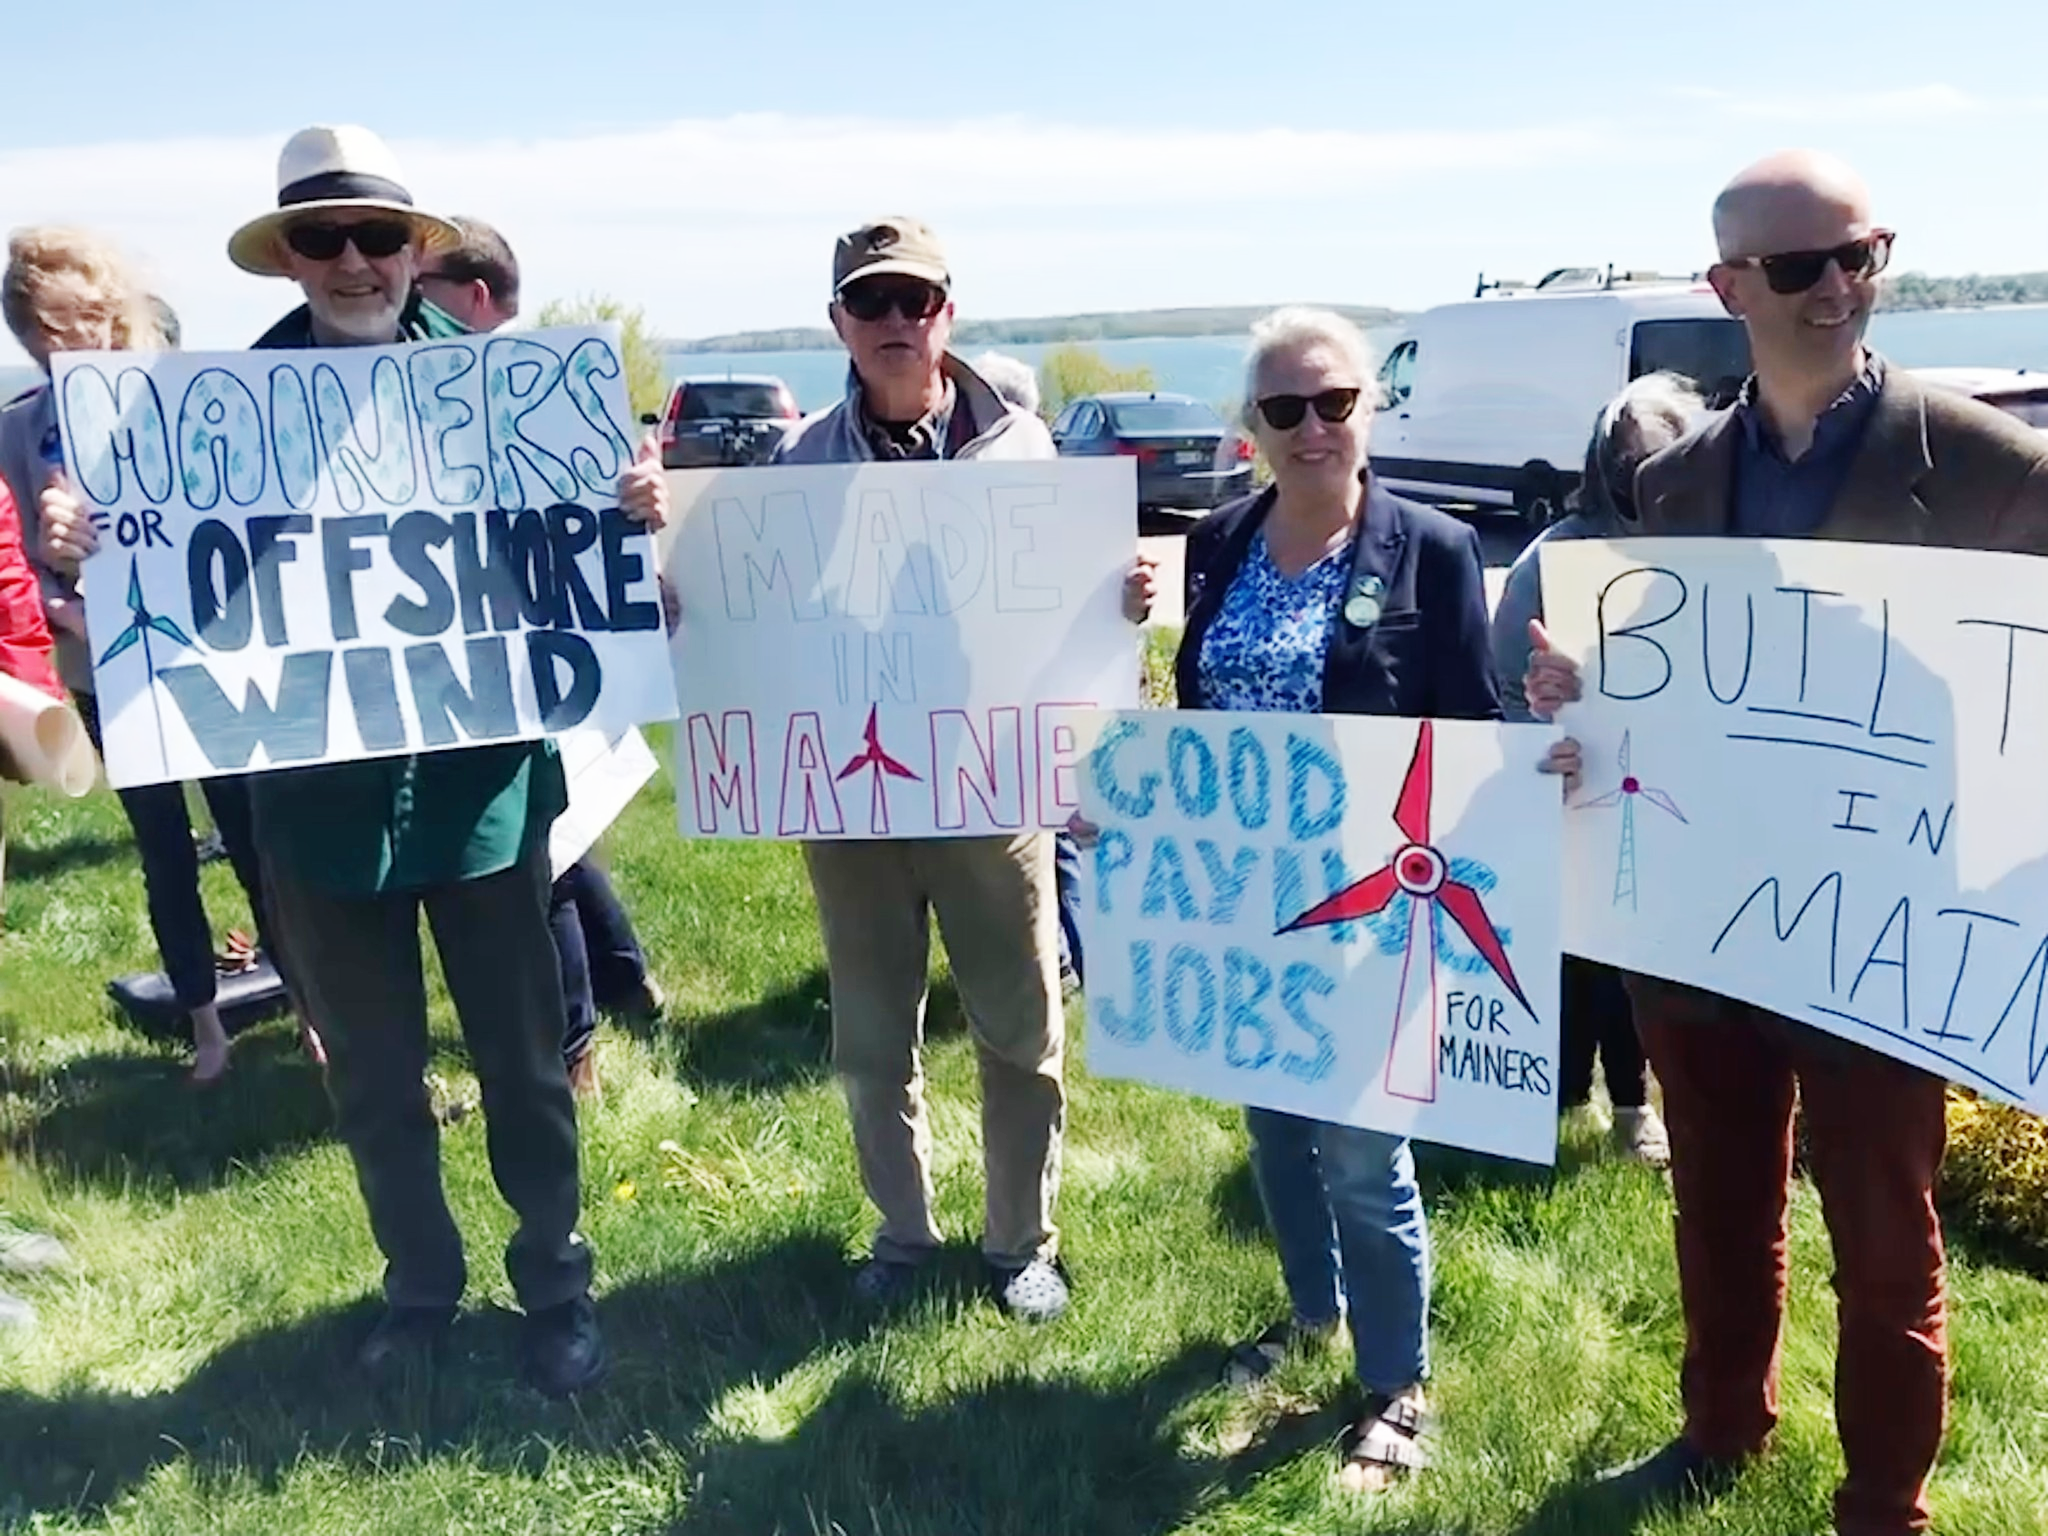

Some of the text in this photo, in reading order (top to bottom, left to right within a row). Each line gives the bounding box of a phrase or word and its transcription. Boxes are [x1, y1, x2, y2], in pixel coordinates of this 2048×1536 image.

[62, 337, 635, 512] MAINERS
[187, 502, 660, 652] OFFSHORE
[711, 483, 1062, 622] MADE
[157, 629, 602, 770] WIND
[831, 631, 917, 706] IN
[1091, 719, 1348, 841] GOOD
[1832, 789, 1954, 855] IN
[1095, 939, 1338, 1085] JOBS
[1439, 1035, 1552, 1096] MAINERS
[1446, 991, 1512, 1035] FOR
